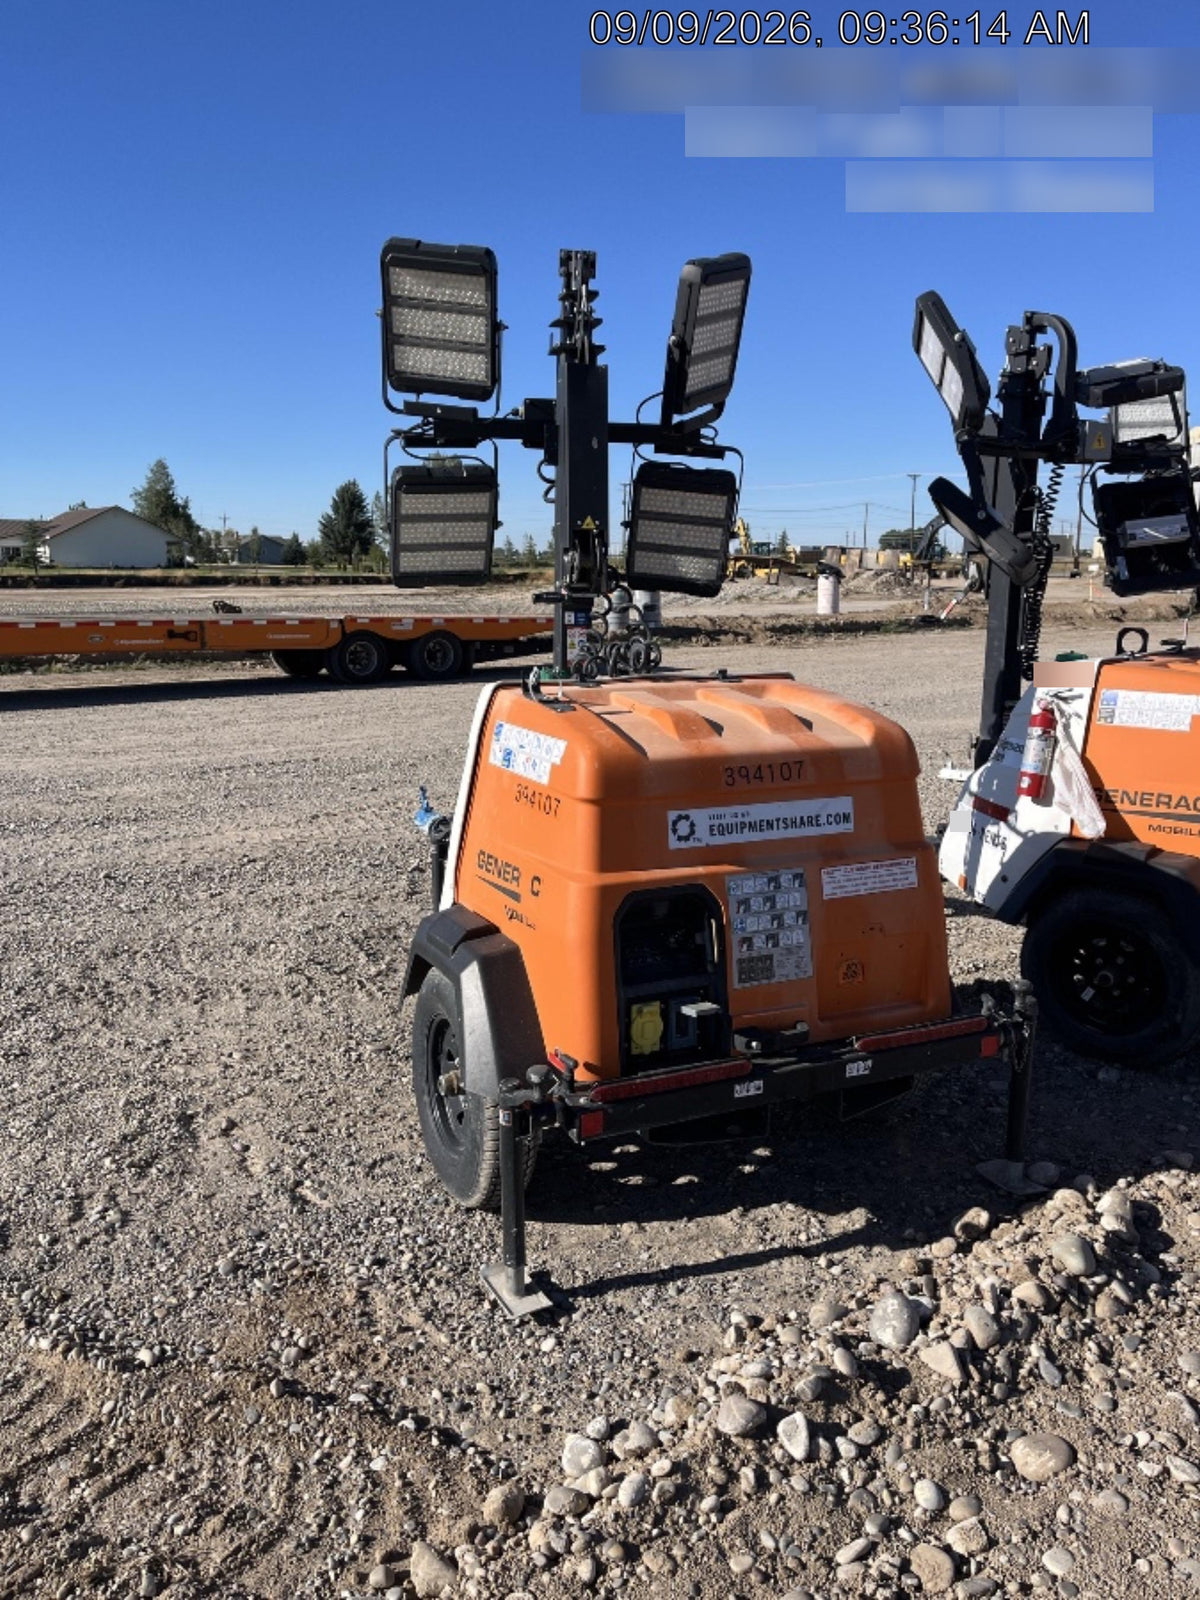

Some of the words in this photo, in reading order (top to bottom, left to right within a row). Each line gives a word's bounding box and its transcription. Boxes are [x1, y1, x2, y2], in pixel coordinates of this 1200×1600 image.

[724, 760, 804, 787] 394107
[514, 783, 561, 817] 394107
[708, 812, 852, 837] EQUIPMENTSHARE.COM
[1148, 824, 1200, 836] MOBIL
